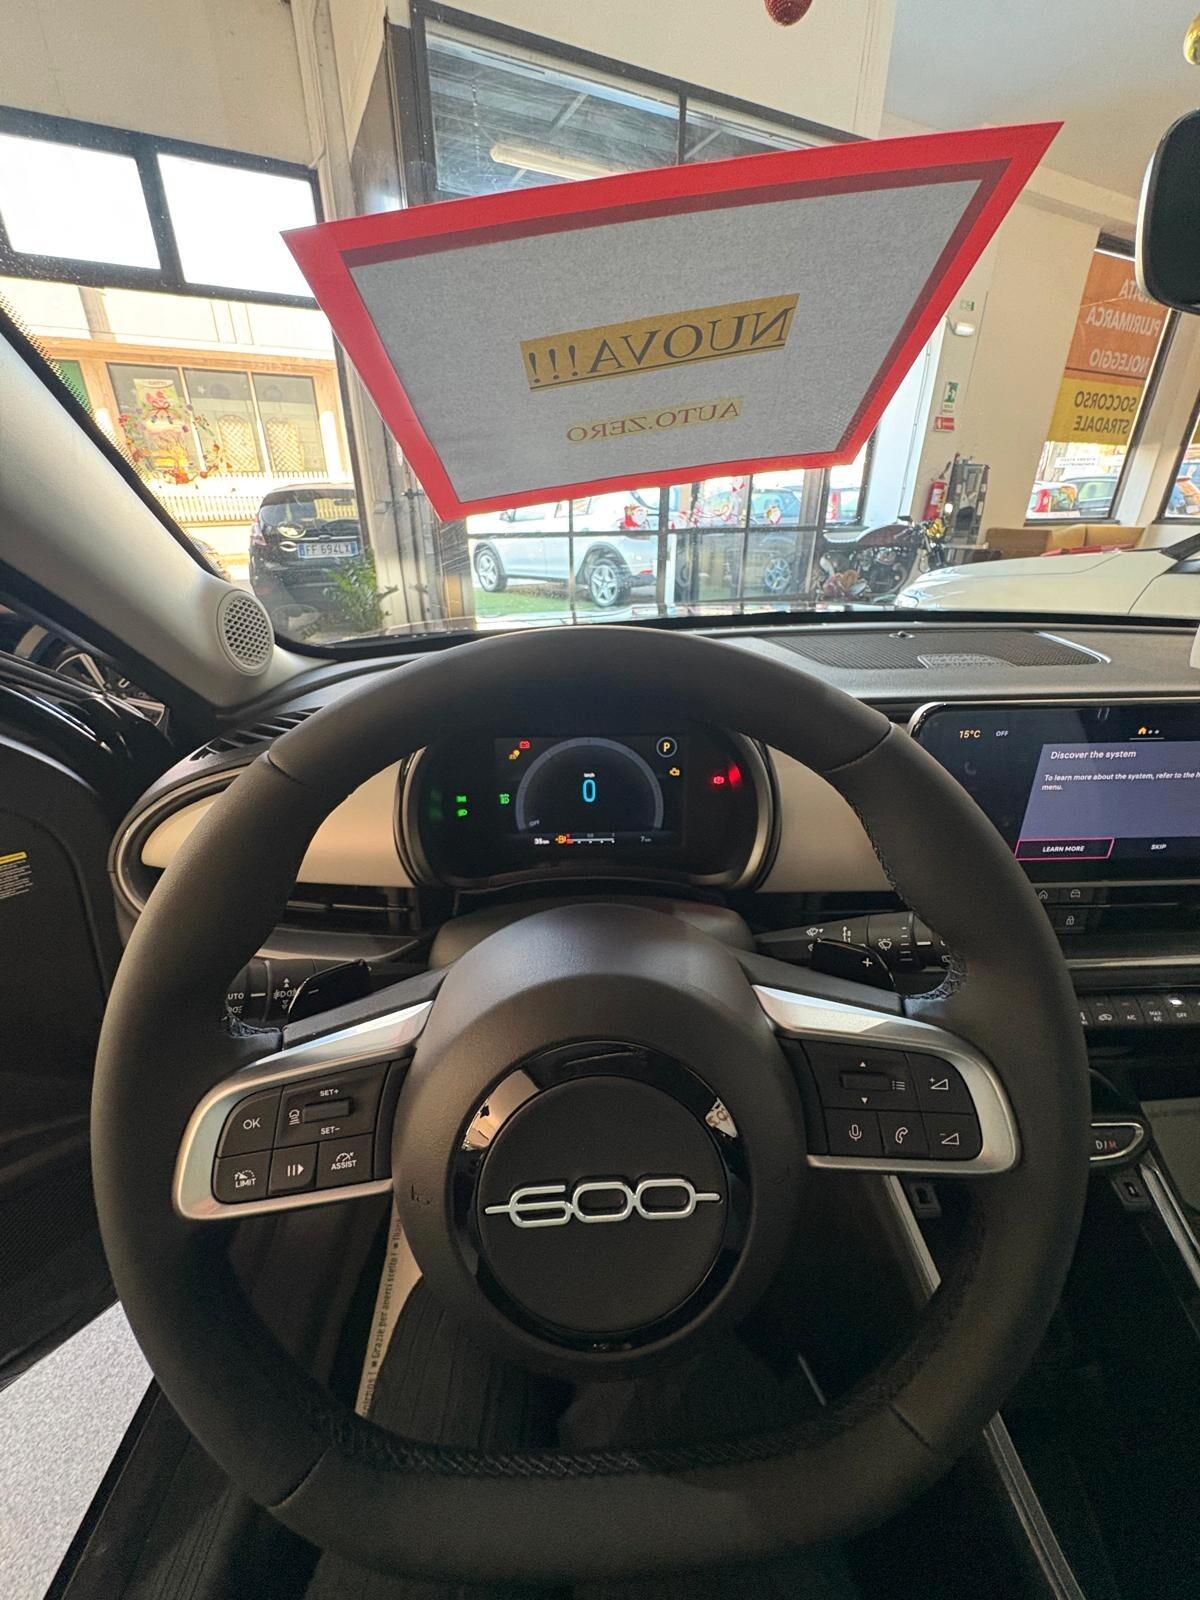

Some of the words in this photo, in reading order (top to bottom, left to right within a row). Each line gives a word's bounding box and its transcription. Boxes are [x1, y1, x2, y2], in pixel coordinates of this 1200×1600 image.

[959, 729, 981, 739] 15°C
[663, 742, 671, 753] P
[1050, 751, 1089, 760] Discover
[1089, 750, 1104, 759] the
[1105, 750, 1137, 760] system
[1044, 774, 1053, 782] To
[1092, 773, 1114, 781] about
[1127, 773, 1155, 782] system,
[1155, 772, 1174, 780] refer
[582, 779, 596, 803] 0
[227, 992, 245, 1000] UTO
[319, 1089, 340, 1097] SET+
[242, 1117, 261, 1130] OK
[330, 1159, 358, 1170] ASSIST
[235, 1178, 257, 1188] LIMIT
[509, 1178, 697, 1229] 600
